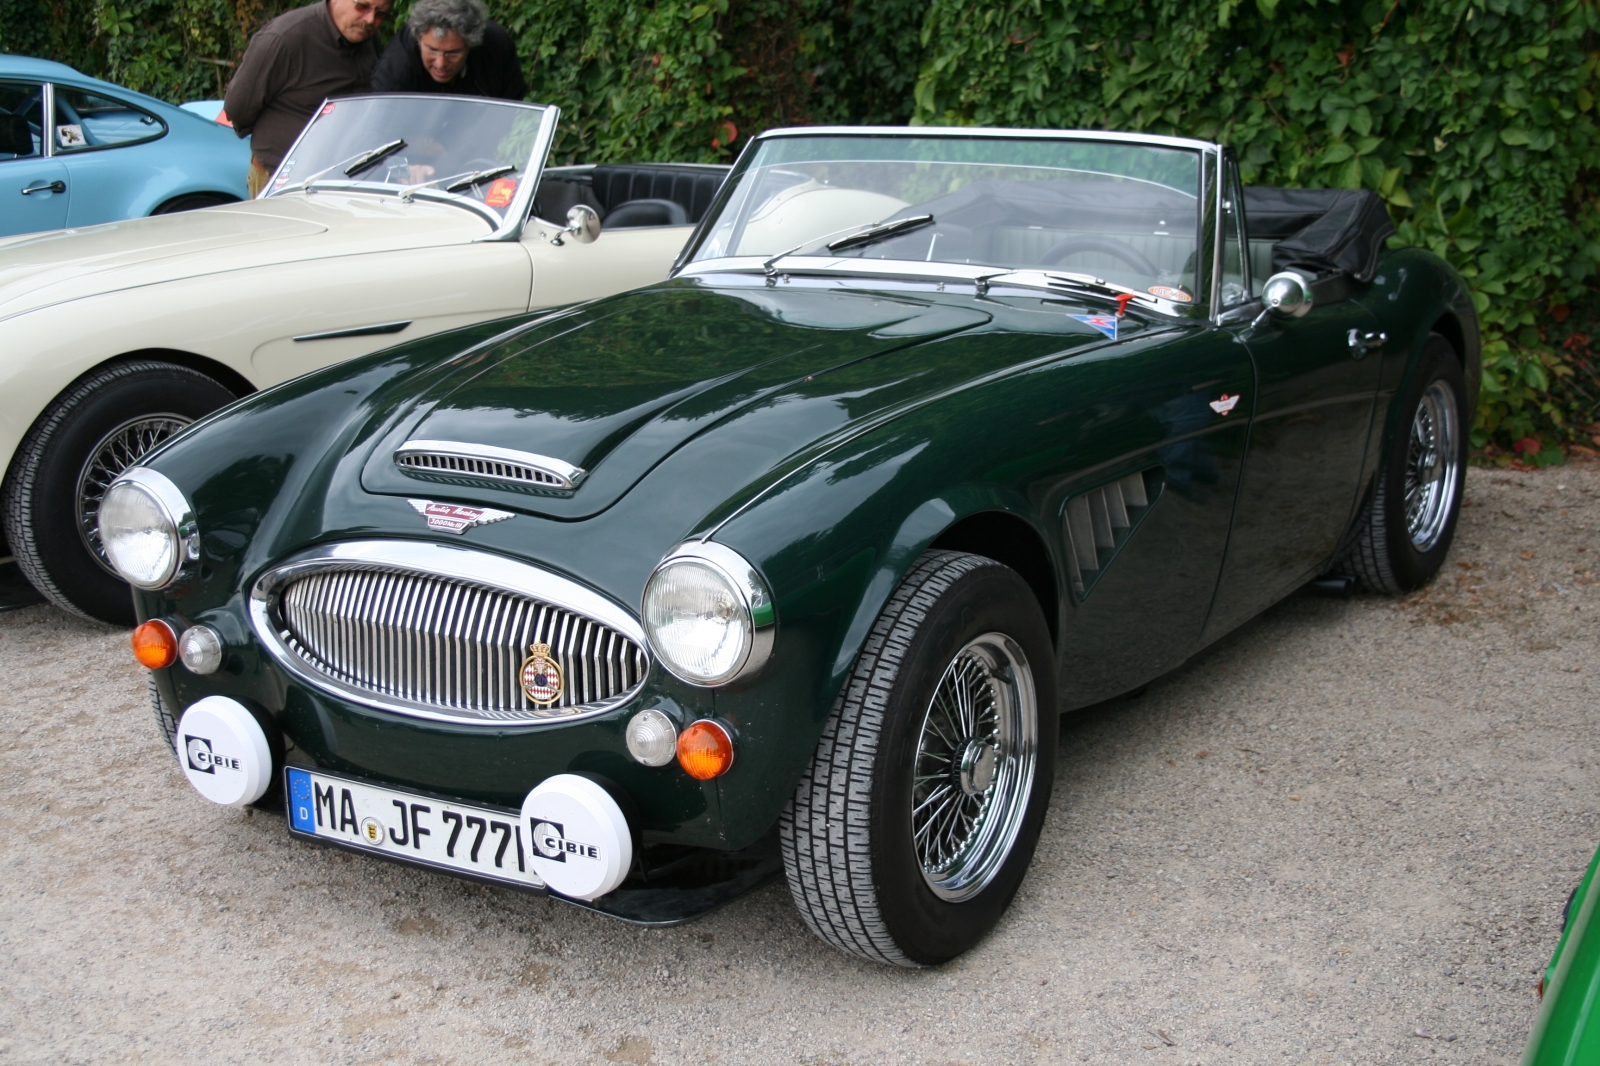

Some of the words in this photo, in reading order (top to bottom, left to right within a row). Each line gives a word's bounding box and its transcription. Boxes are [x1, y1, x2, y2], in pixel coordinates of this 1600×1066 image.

[427, 504, 450, 514] Austin
[452, 507, 480, 519] Healey
[300, 806, 308, 821] D
[314, 780, 360, 836] MA
[389, 799, 432, 850] JF
